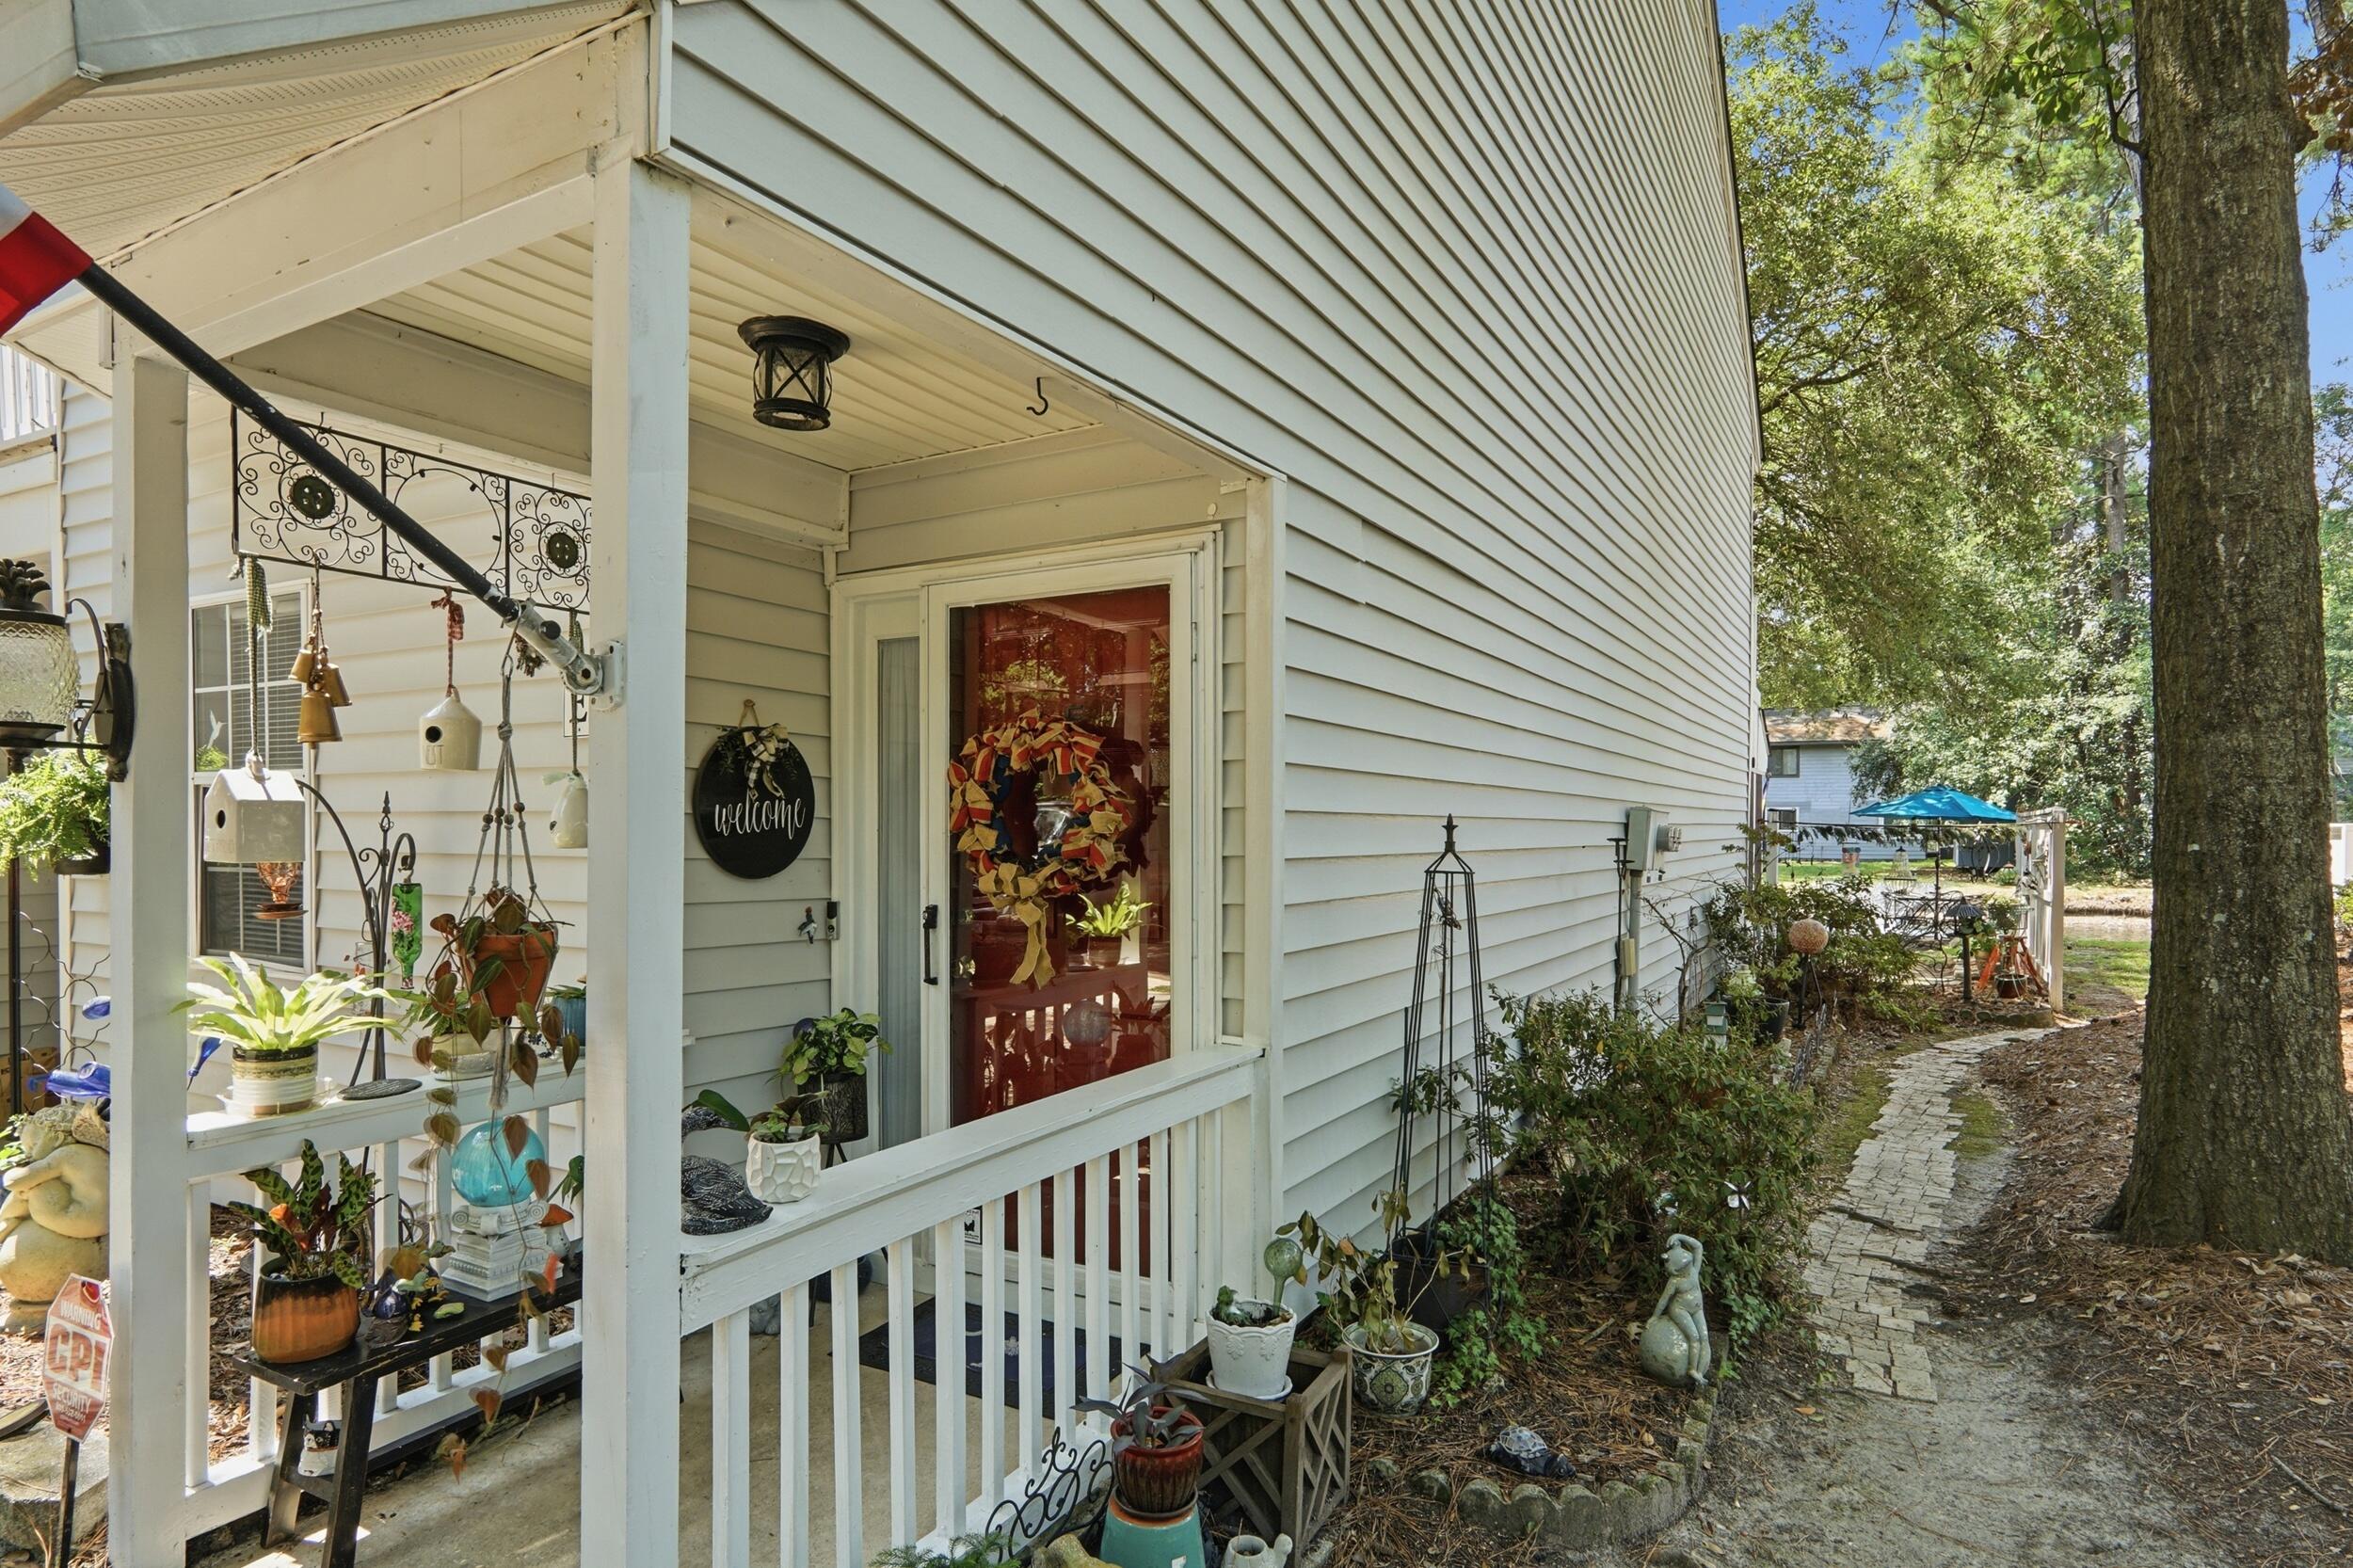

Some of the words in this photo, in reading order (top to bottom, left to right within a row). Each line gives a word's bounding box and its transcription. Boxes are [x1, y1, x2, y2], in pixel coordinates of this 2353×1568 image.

[714, 787, 806, 840] welcome
[60, 1301, 102, 1330] WARNING
[48, 1323, 106, 1391] CPI
[53, 1382, 91, 1414] SECURITY
